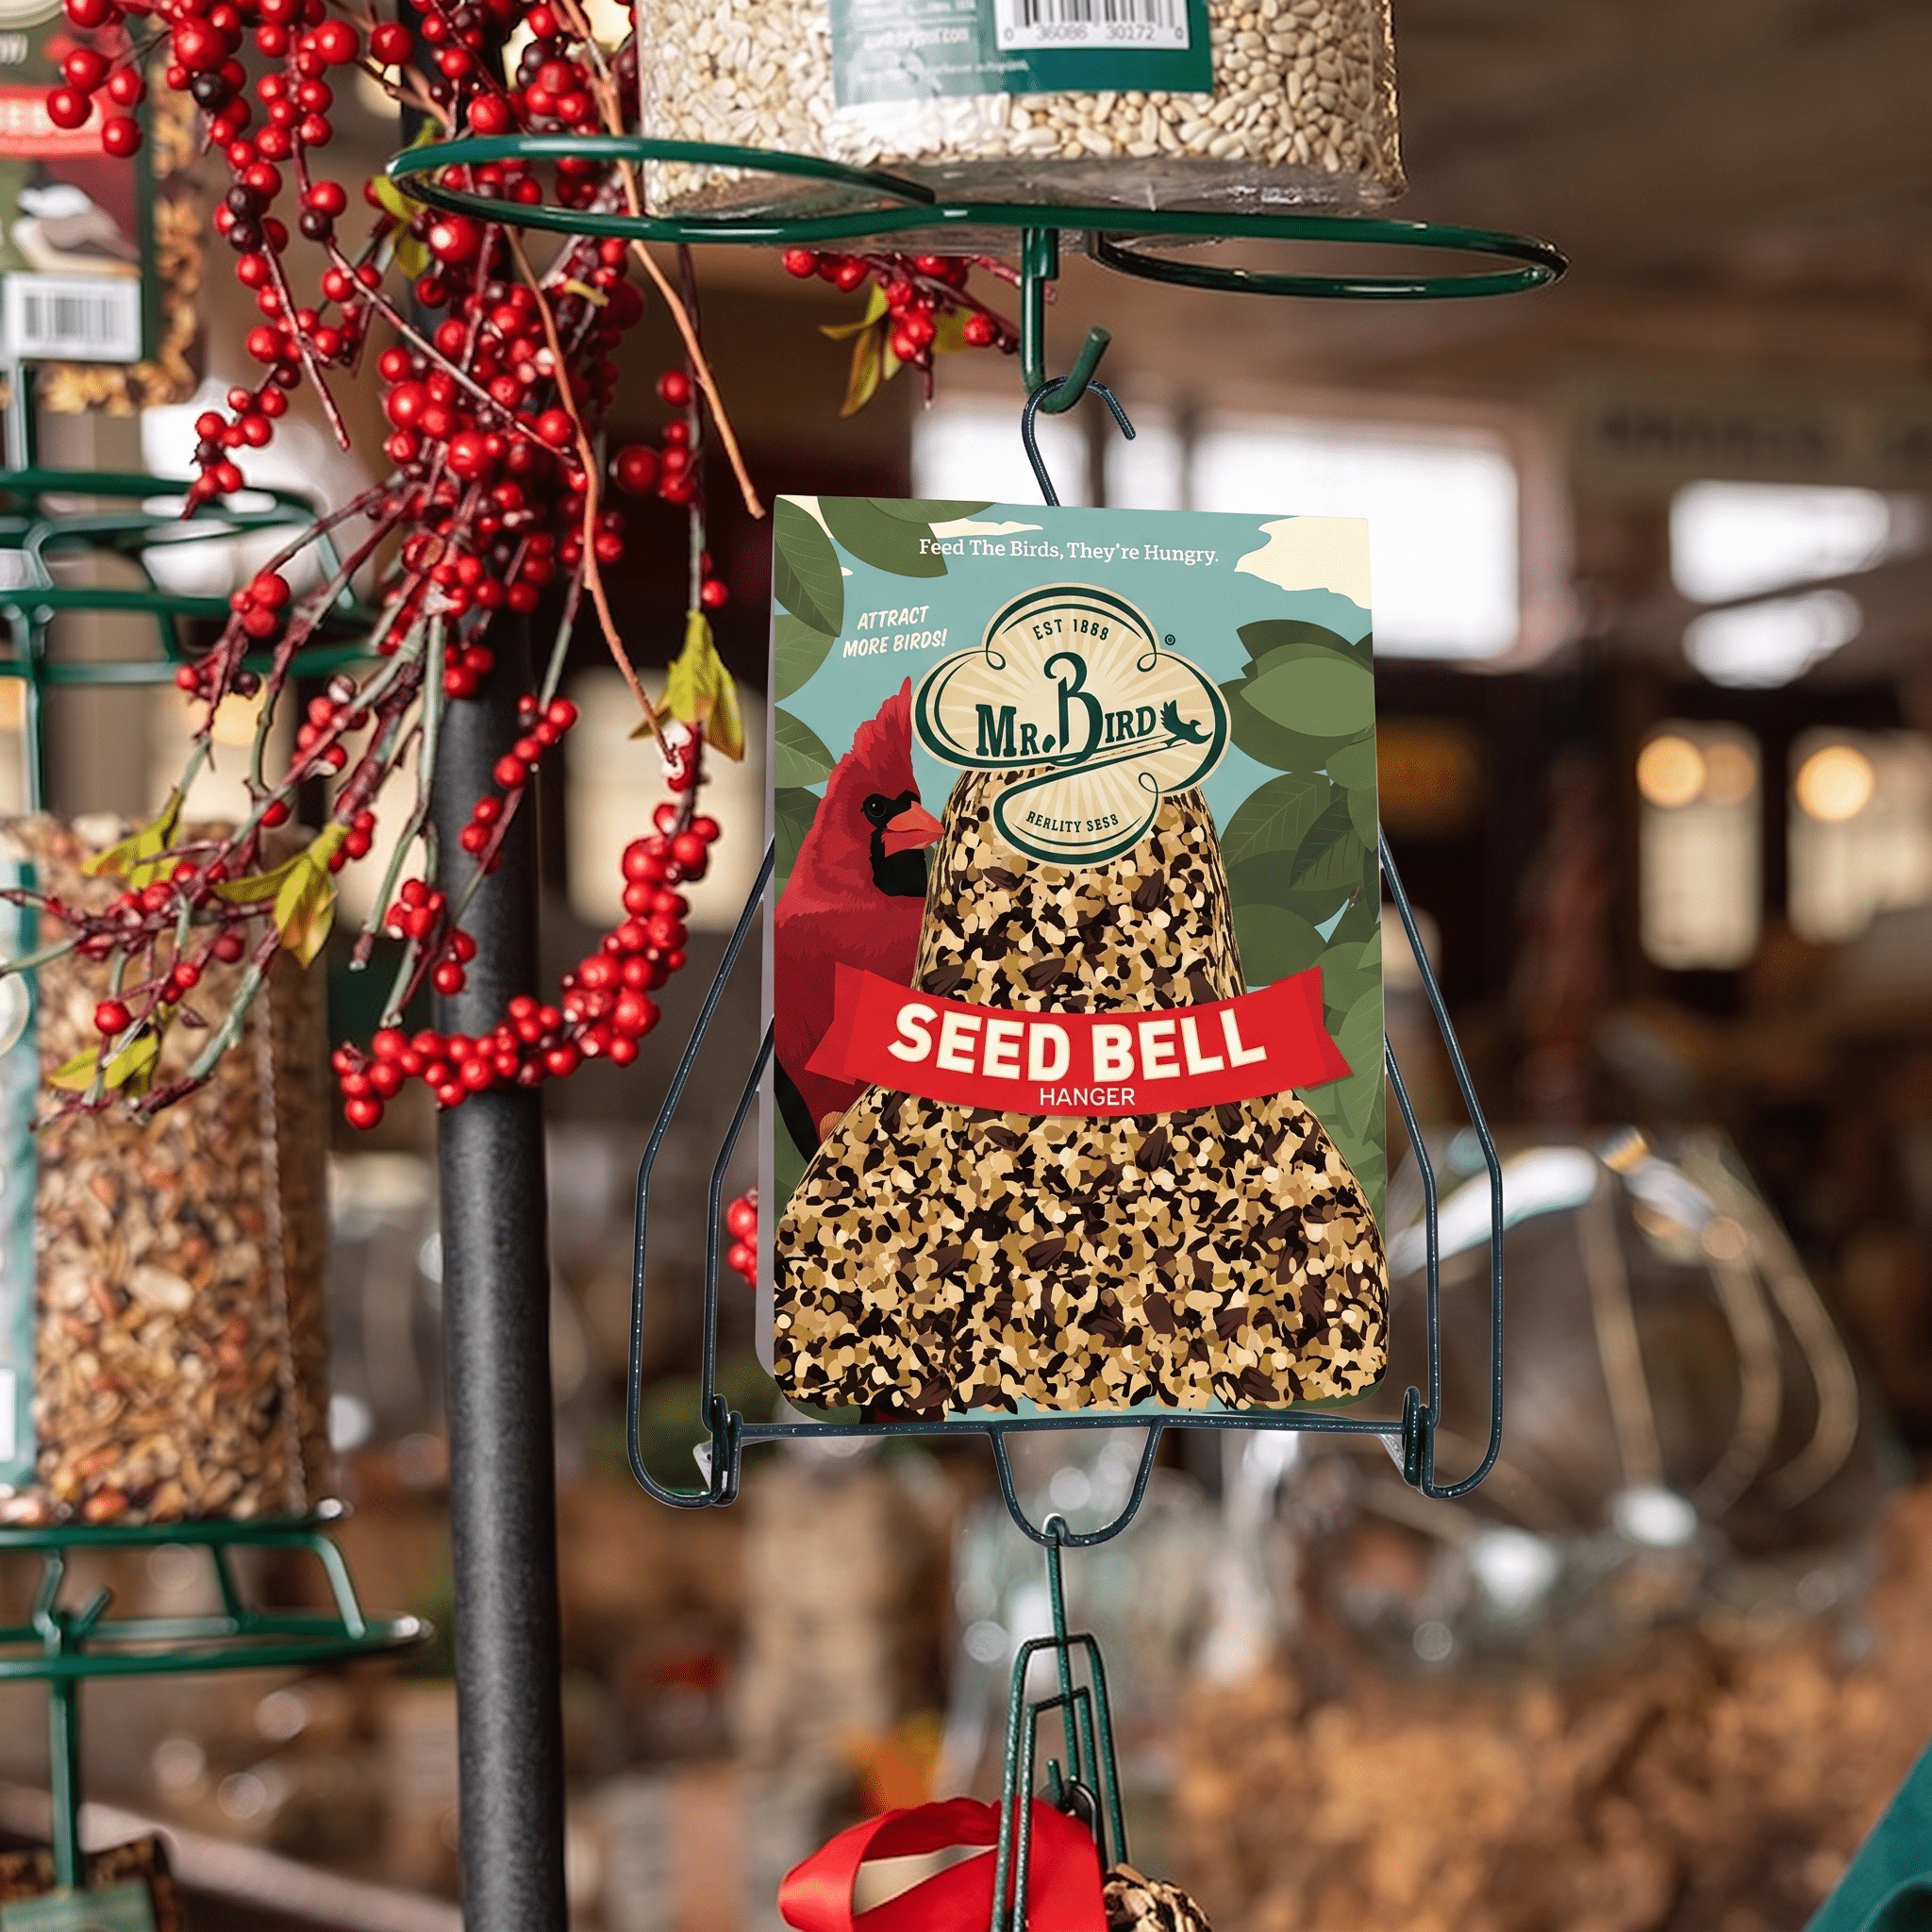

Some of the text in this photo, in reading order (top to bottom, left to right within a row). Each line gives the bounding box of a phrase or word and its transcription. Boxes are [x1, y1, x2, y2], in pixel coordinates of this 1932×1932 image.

[919, 539, 1220, 566] Feed The Birds, They're Hungry.
[857, 605, 930, 631] ATTRACT
[1032, 619, 1062, 641] EST
[842, 627, 948, 658] MORE BIRDS!
[887, 1003, 1268, 1084] SEED BELL
[1039, 1086, 1136, 1107] HANGER
